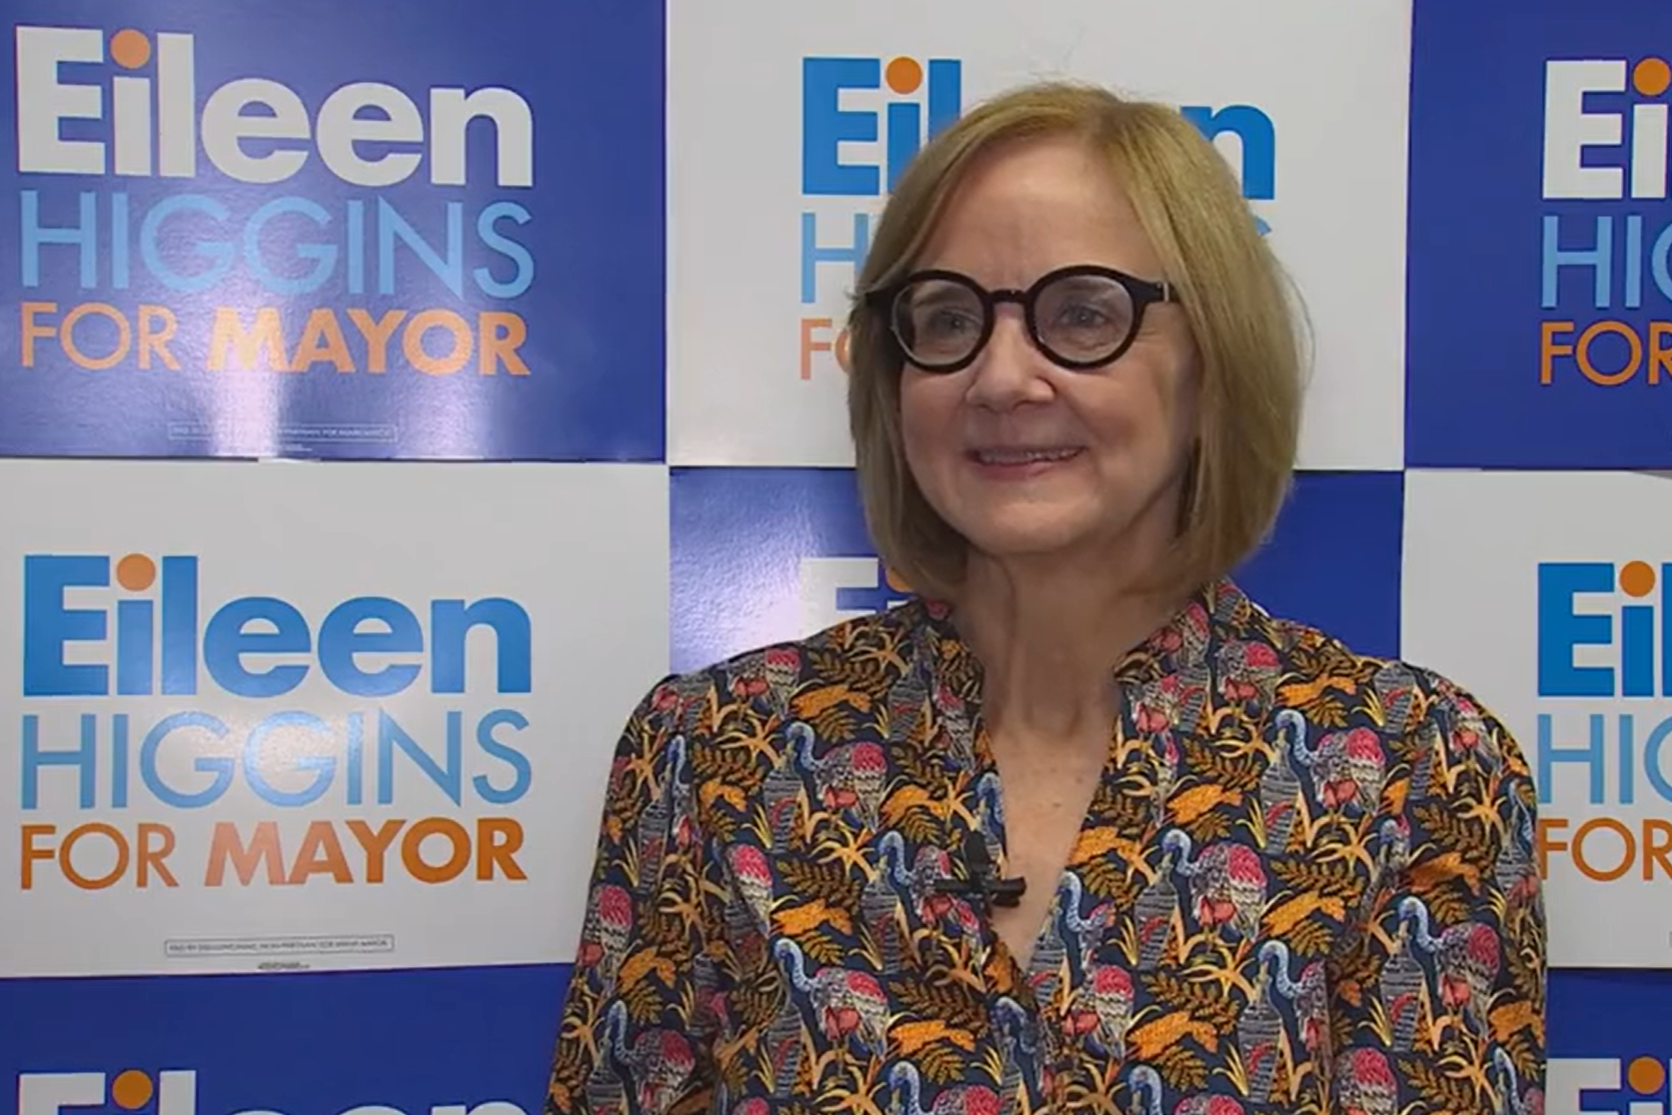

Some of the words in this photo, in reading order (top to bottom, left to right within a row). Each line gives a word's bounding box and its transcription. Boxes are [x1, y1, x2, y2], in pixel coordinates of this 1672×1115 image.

[16, 26, 534, 188] Eileen
[802, 56, 1276, 200] Eiln
[20, 190, 535, 299] HIGGINS
[20, 302, 181, 371] FOR
[207, 308, 531, 376] MAYOR
[23, 553, 532, 698] Eileen
[21, 707, 532, 809] HIGGINS
[20, 822, 179, 890] FOR
[204, 817, 528, 887] MAYOR
